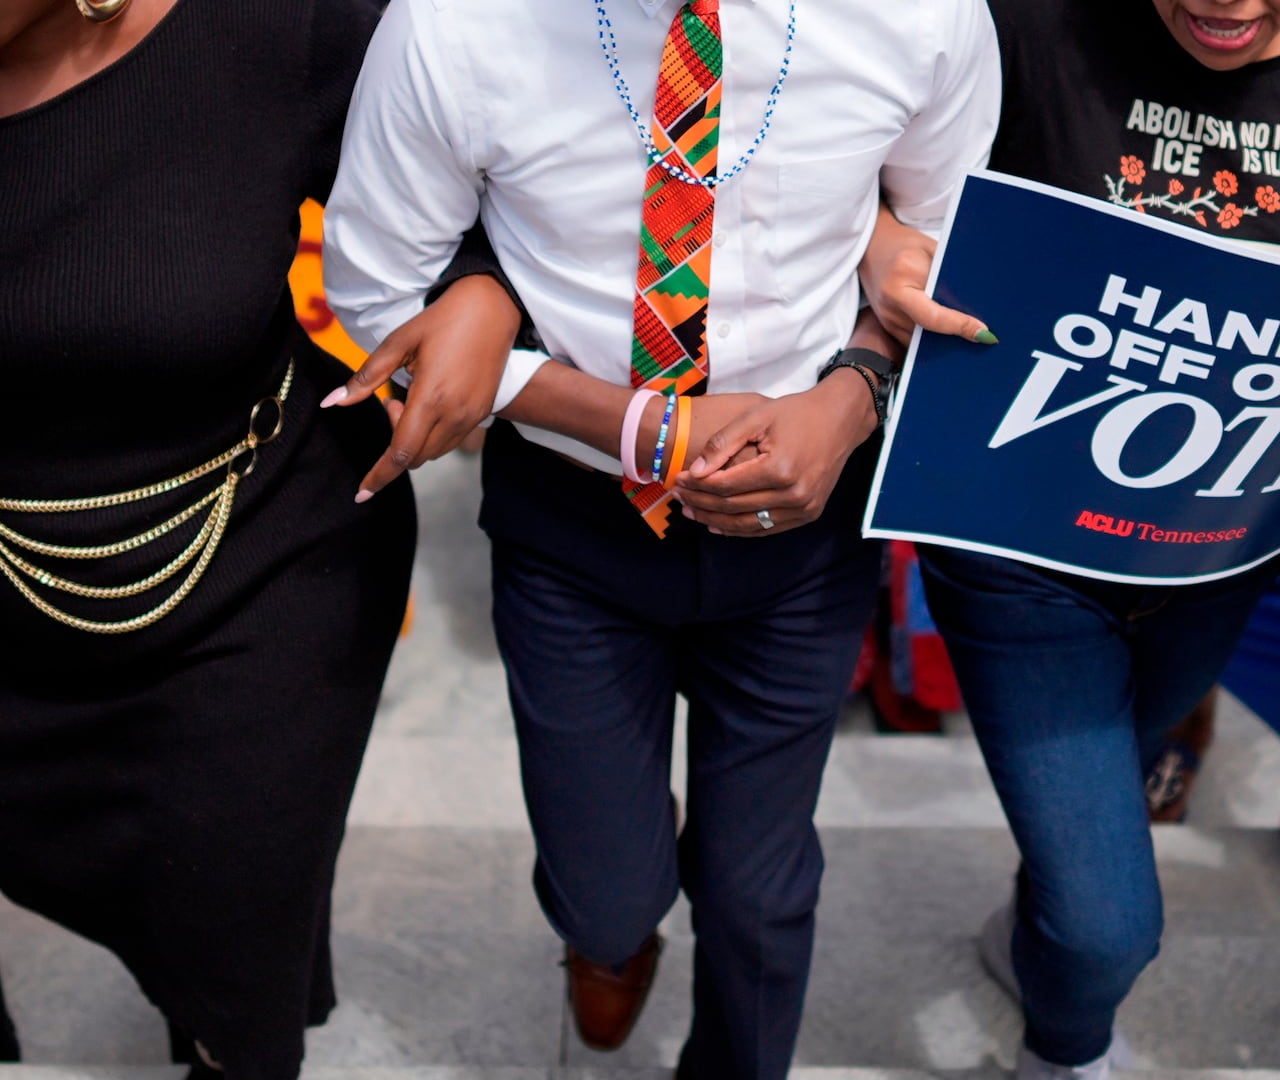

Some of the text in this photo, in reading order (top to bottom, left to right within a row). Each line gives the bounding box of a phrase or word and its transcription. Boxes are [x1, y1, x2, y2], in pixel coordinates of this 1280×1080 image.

[1126, 98, 1237, 150] ABOLISH
[1239, 121, 1271, 150] NO
[1151, 137, 1204, 178] ICE
[1241, 147, 1262, 174] IS
[1052, 313, 1217, 385] OFF
[1075, 509, 1248, 545] ACLU Tennessee
